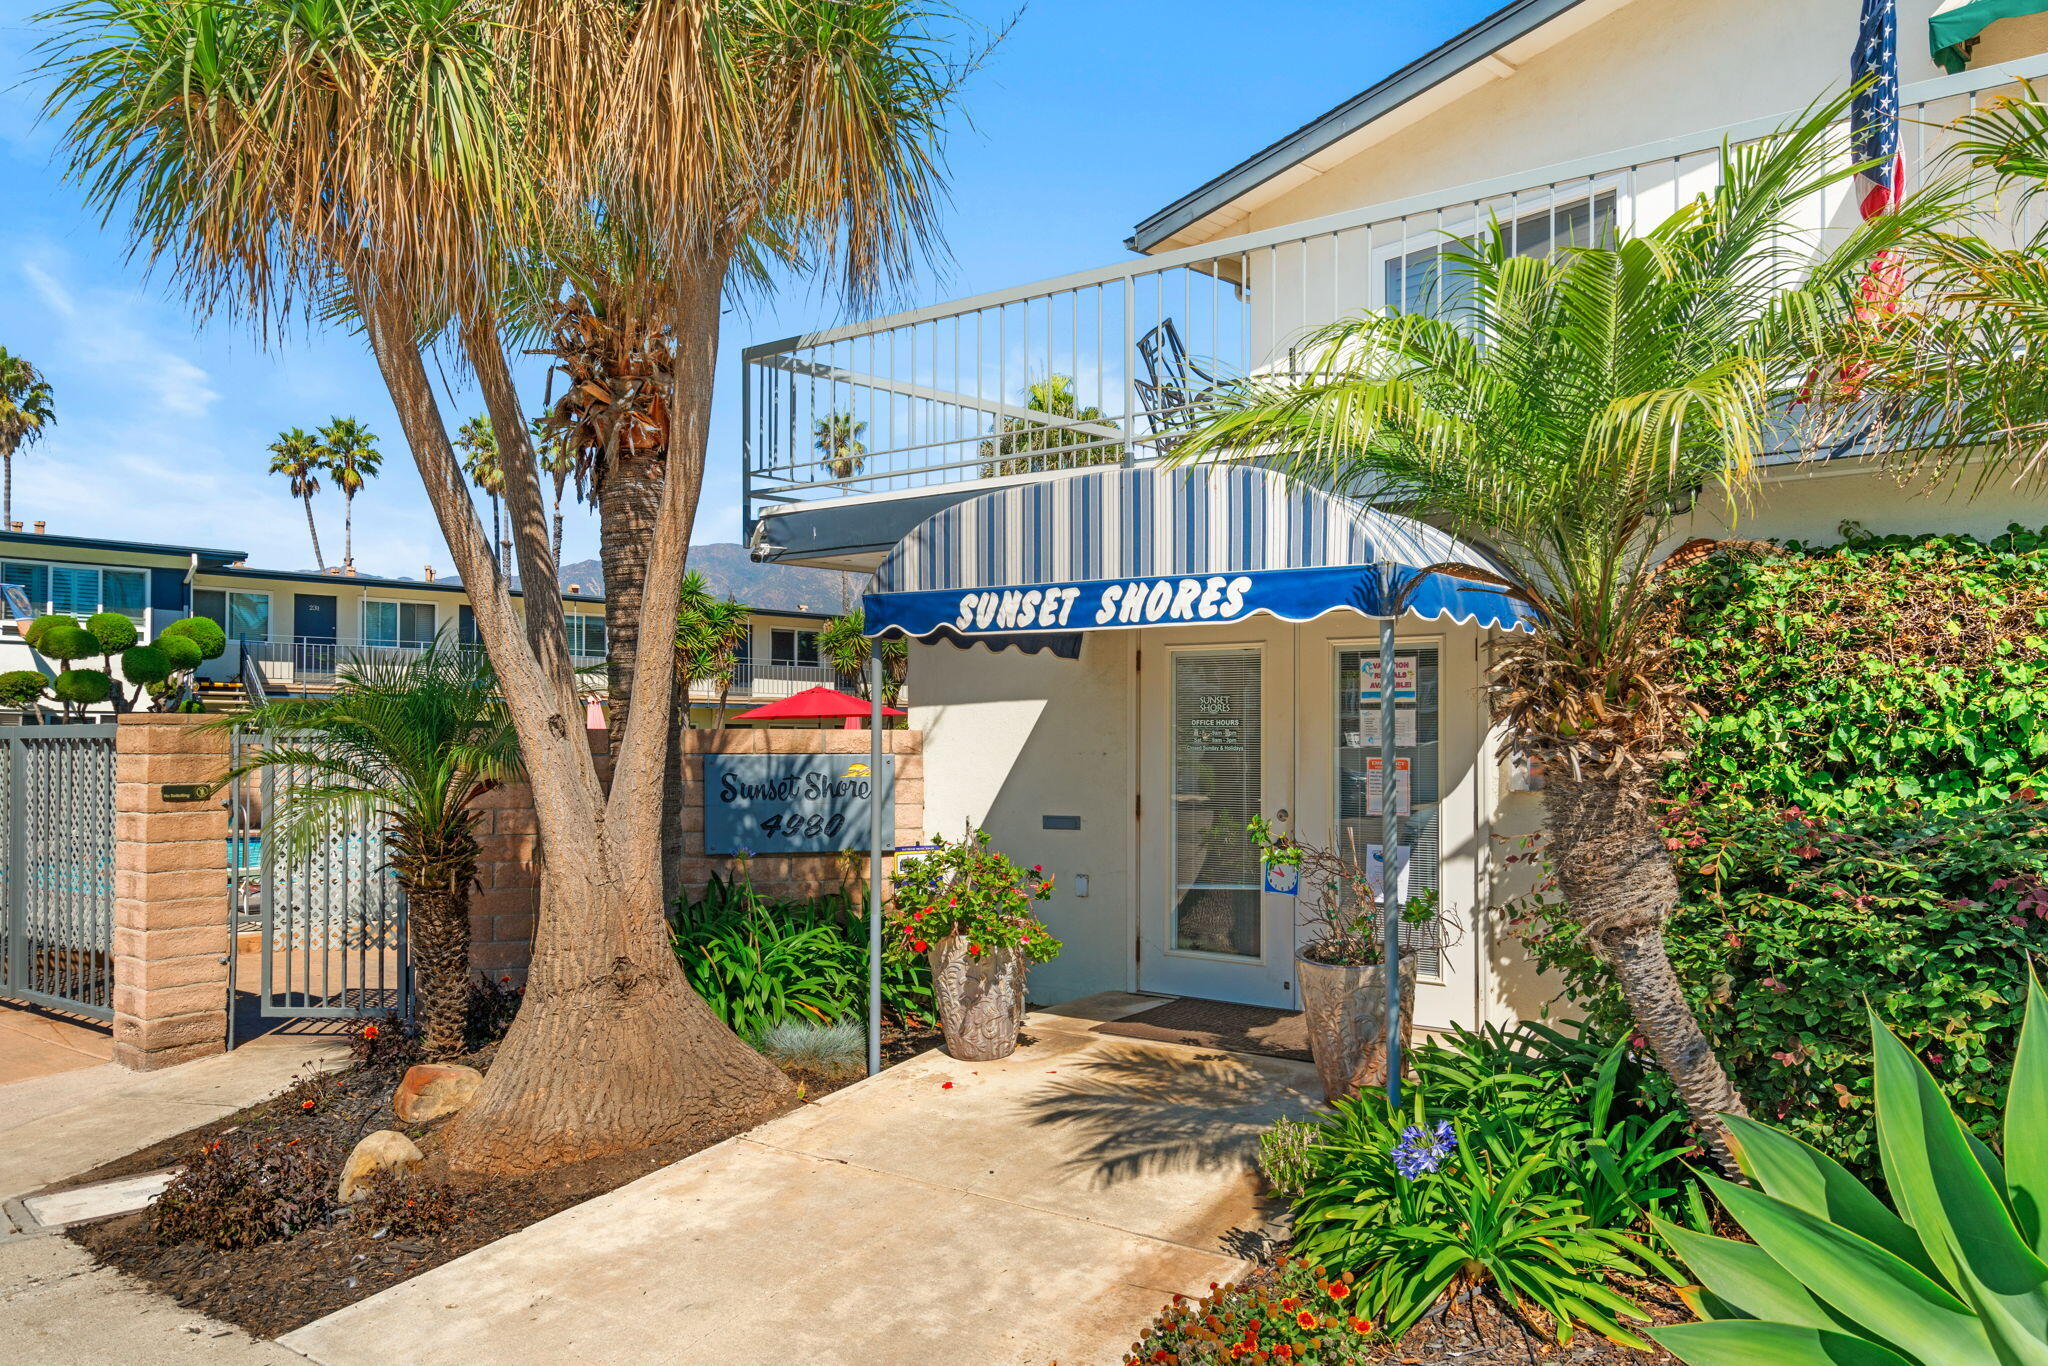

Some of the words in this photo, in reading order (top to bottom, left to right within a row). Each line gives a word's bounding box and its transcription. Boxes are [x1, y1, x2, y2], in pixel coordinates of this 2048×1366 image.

[957, 587, 1081, 631] SUNSET
[1095, 576, 1253, 625] SHORES
[1200, 695, 1230, 704] SUNSET
[1200, 704, 1230, 714] SHORES
[720, 772, 802, 803] Sunset
[804, 772, 872, 801] Shore
[760, 813, 846, 839] 4980
